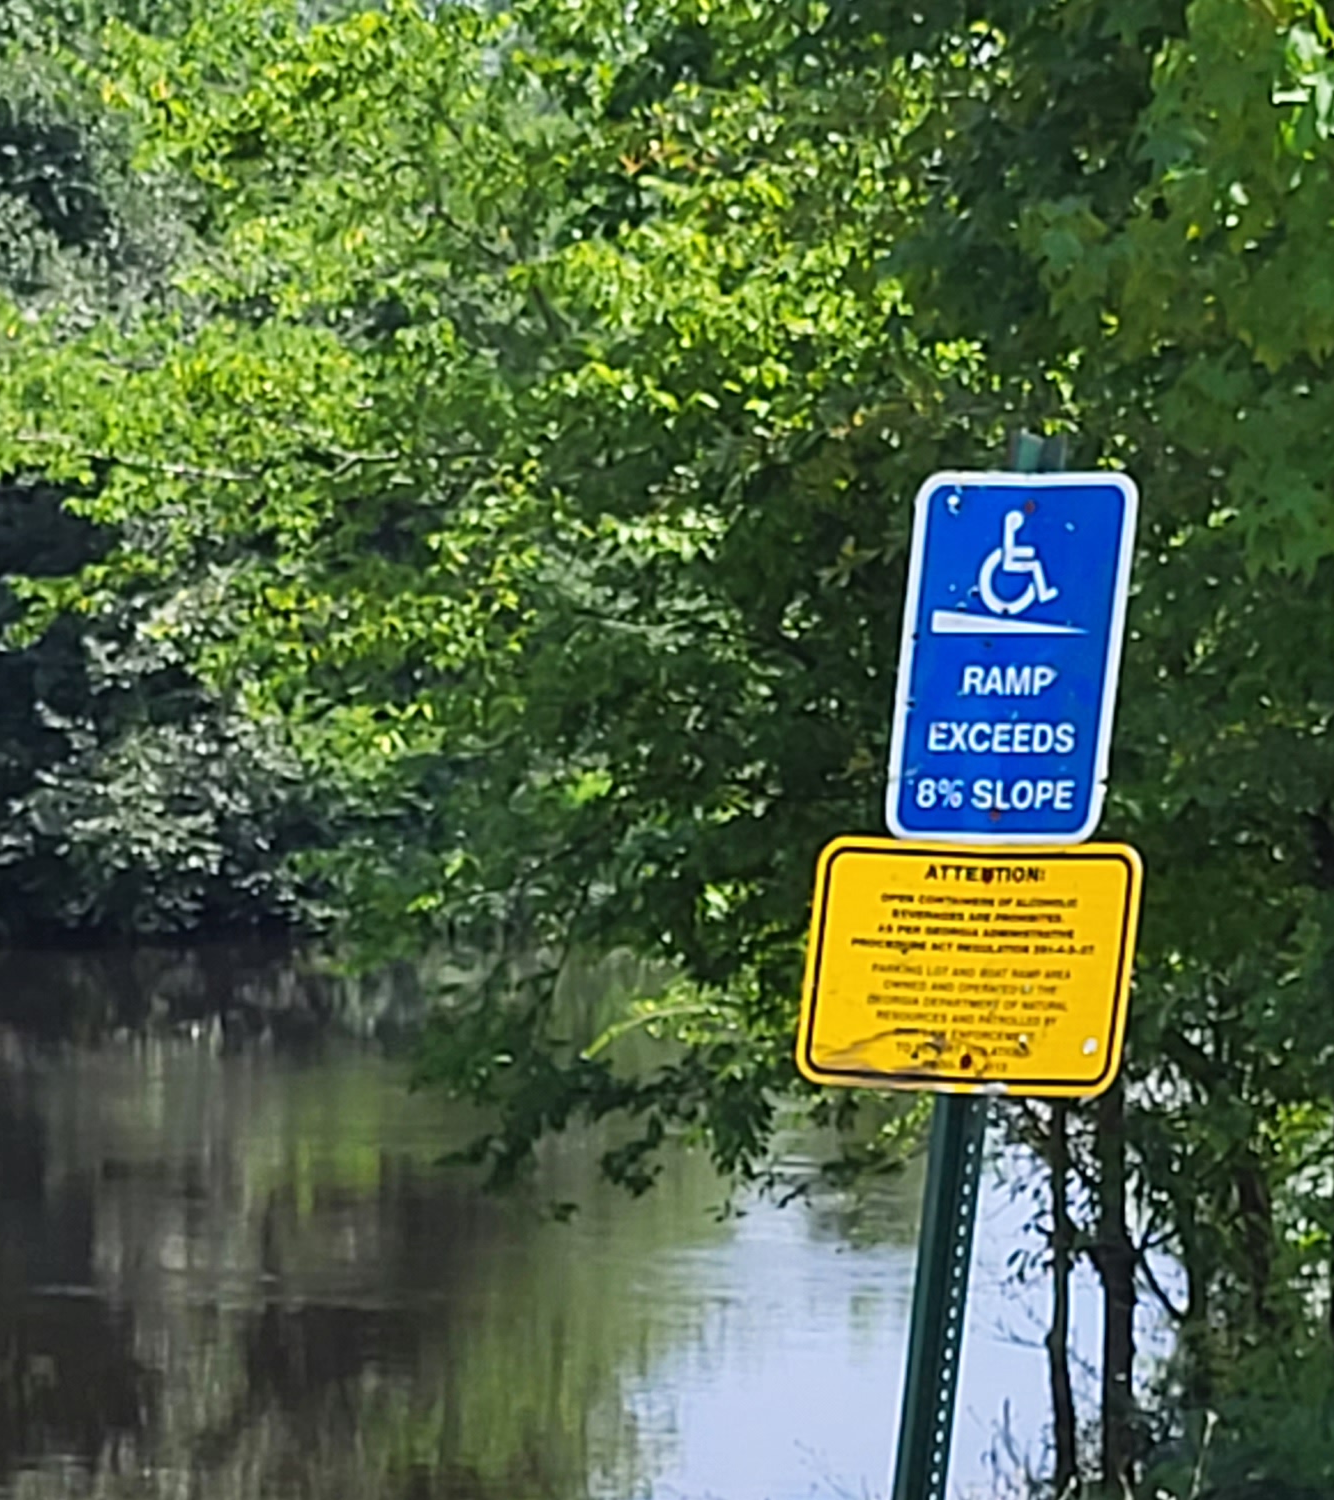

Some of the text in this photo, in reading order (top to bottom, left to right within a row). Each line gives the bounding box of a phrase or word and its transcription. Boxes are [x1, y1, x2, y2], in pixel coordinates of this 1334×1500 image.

[962, 665, 1058, 696] RAMP
[927, 722, 1076, 754] EXCEEDS
[915, 778, 1076, 811] 8% SLOPE
[924, 863, 1046, 885] ATTETION:
[880, 893, 1078, 909] OPEN CONTAINERS OF ALCOHOLIC
[891, 908, 965, 921] BEVERAGES
[969, 913, 991, 922] ARE
[877, 923, 1074, 940] AS PER GEORGIA ADMINISTRATIVE
[851, 937, 926, 951] PROCEDURE
[931, 942, 953, 951] ACT
[957, 943, 1030, 955] REGULATION
[871, 963, 1071, 981] PARKING LOT AND BOAT RAMP AREA
[883, 980, 926, 993] OWNED
[931, 981, 955, 993] AND
[958, 983, 1018, 996] OPERATED
[1037, 985, 1057, 996] THE
[867, 992, 1069, 1013] GEORGIA DEPARTMENT OF NATURAL
[875, 1010, 1058, 1028] RESOURCES AND PATROLLED BY
[950, 1028, 1037, 1043] ENFORCEMET
